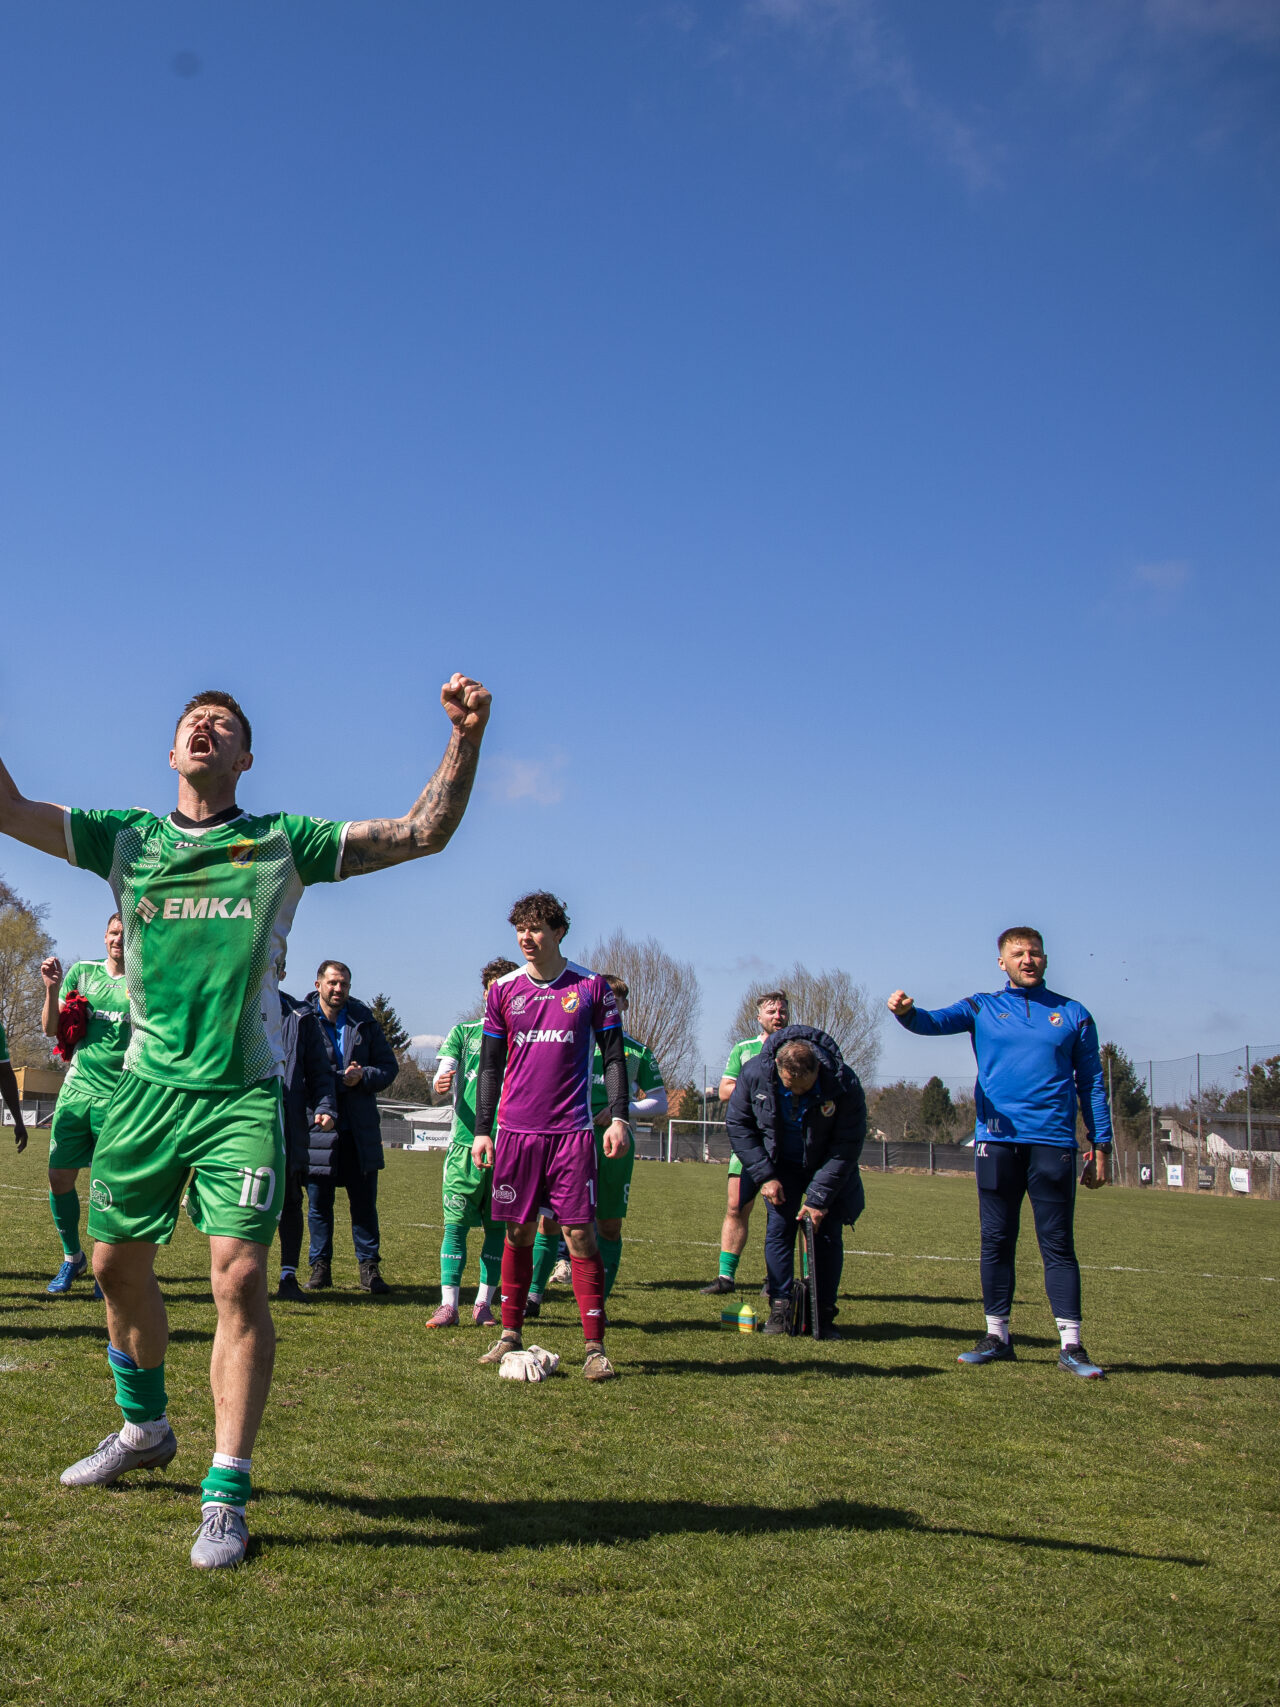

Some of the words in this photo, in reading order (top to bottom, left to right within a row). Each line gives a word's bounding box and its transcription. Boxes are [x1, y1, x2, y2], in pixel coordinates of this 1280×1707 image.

[163, 898, 252, 919] EMKA
[96, 1009, 131, 1023] EMKA
[525, 1029, 575, 1044] EMKA
[238, 1166, 277, 1212] 10
